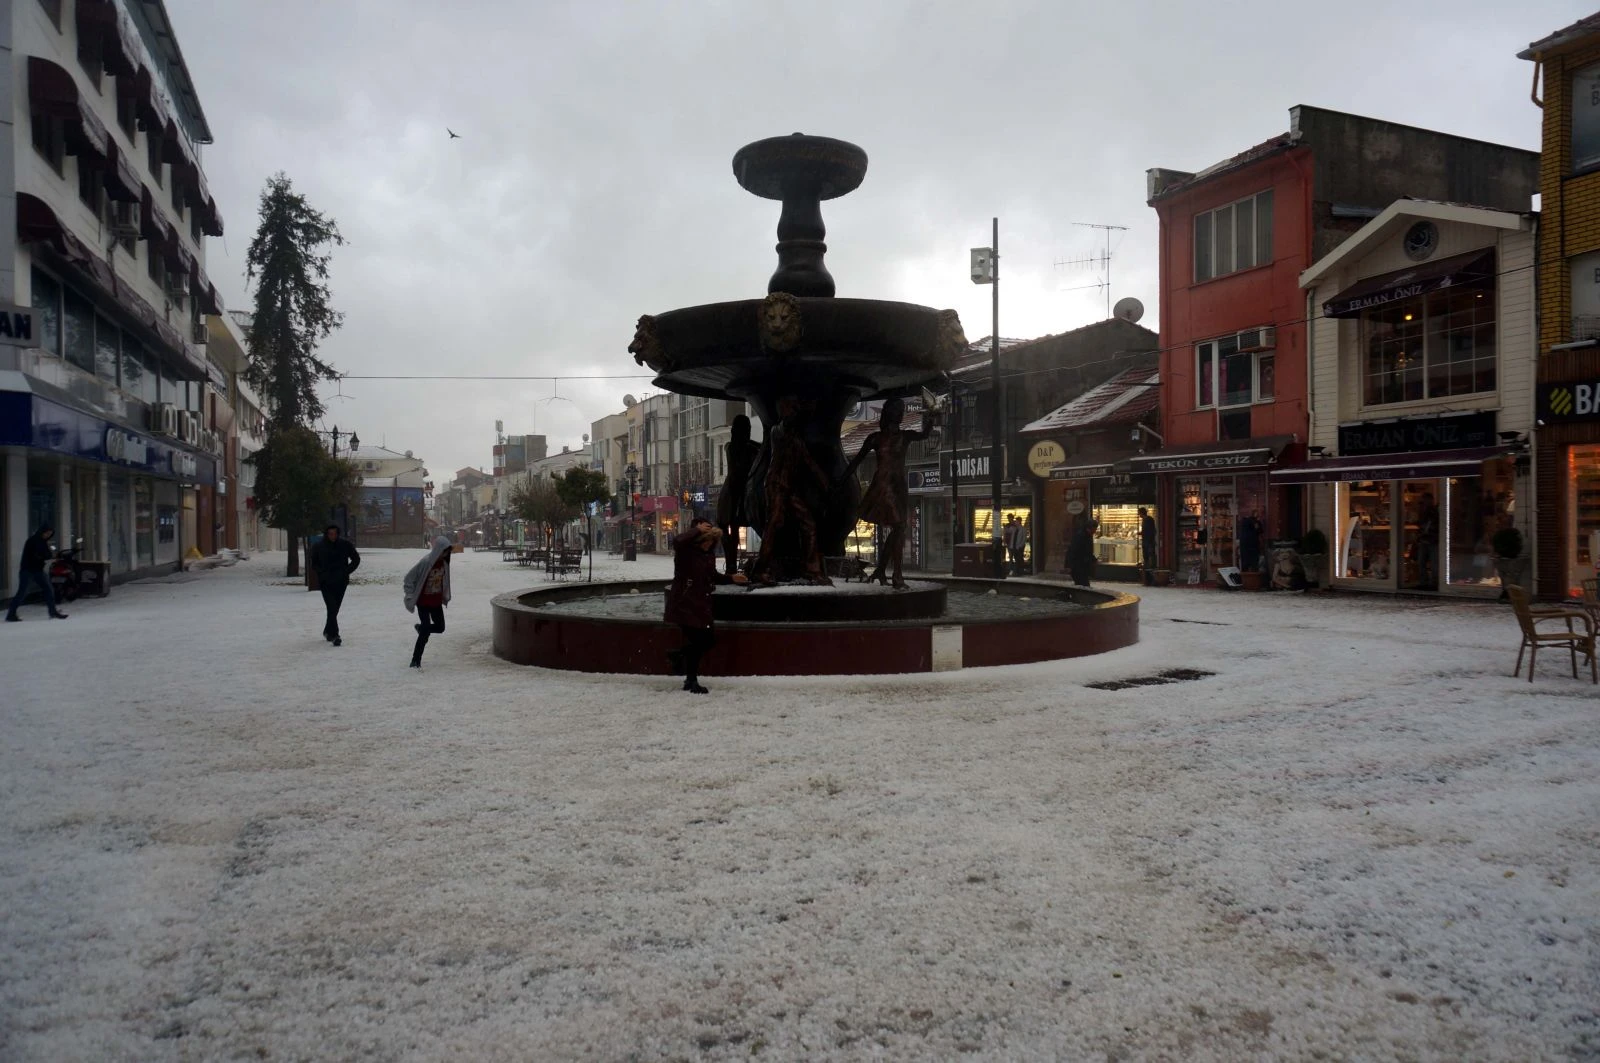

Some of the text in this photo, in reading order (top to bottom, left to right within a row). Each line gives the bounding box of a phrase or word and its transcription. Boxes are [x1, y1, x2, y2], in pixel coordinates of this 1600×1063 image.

[1349, 293, 1389, 311] ERMAN
[1344, 429, 1407, 450] ERMAN
[1413, 422, 1460, 446] ÖNİZ
[1204, 454, 1250, 467] ÇEYİZ
[1109, 474, 1132, 485] ATA
